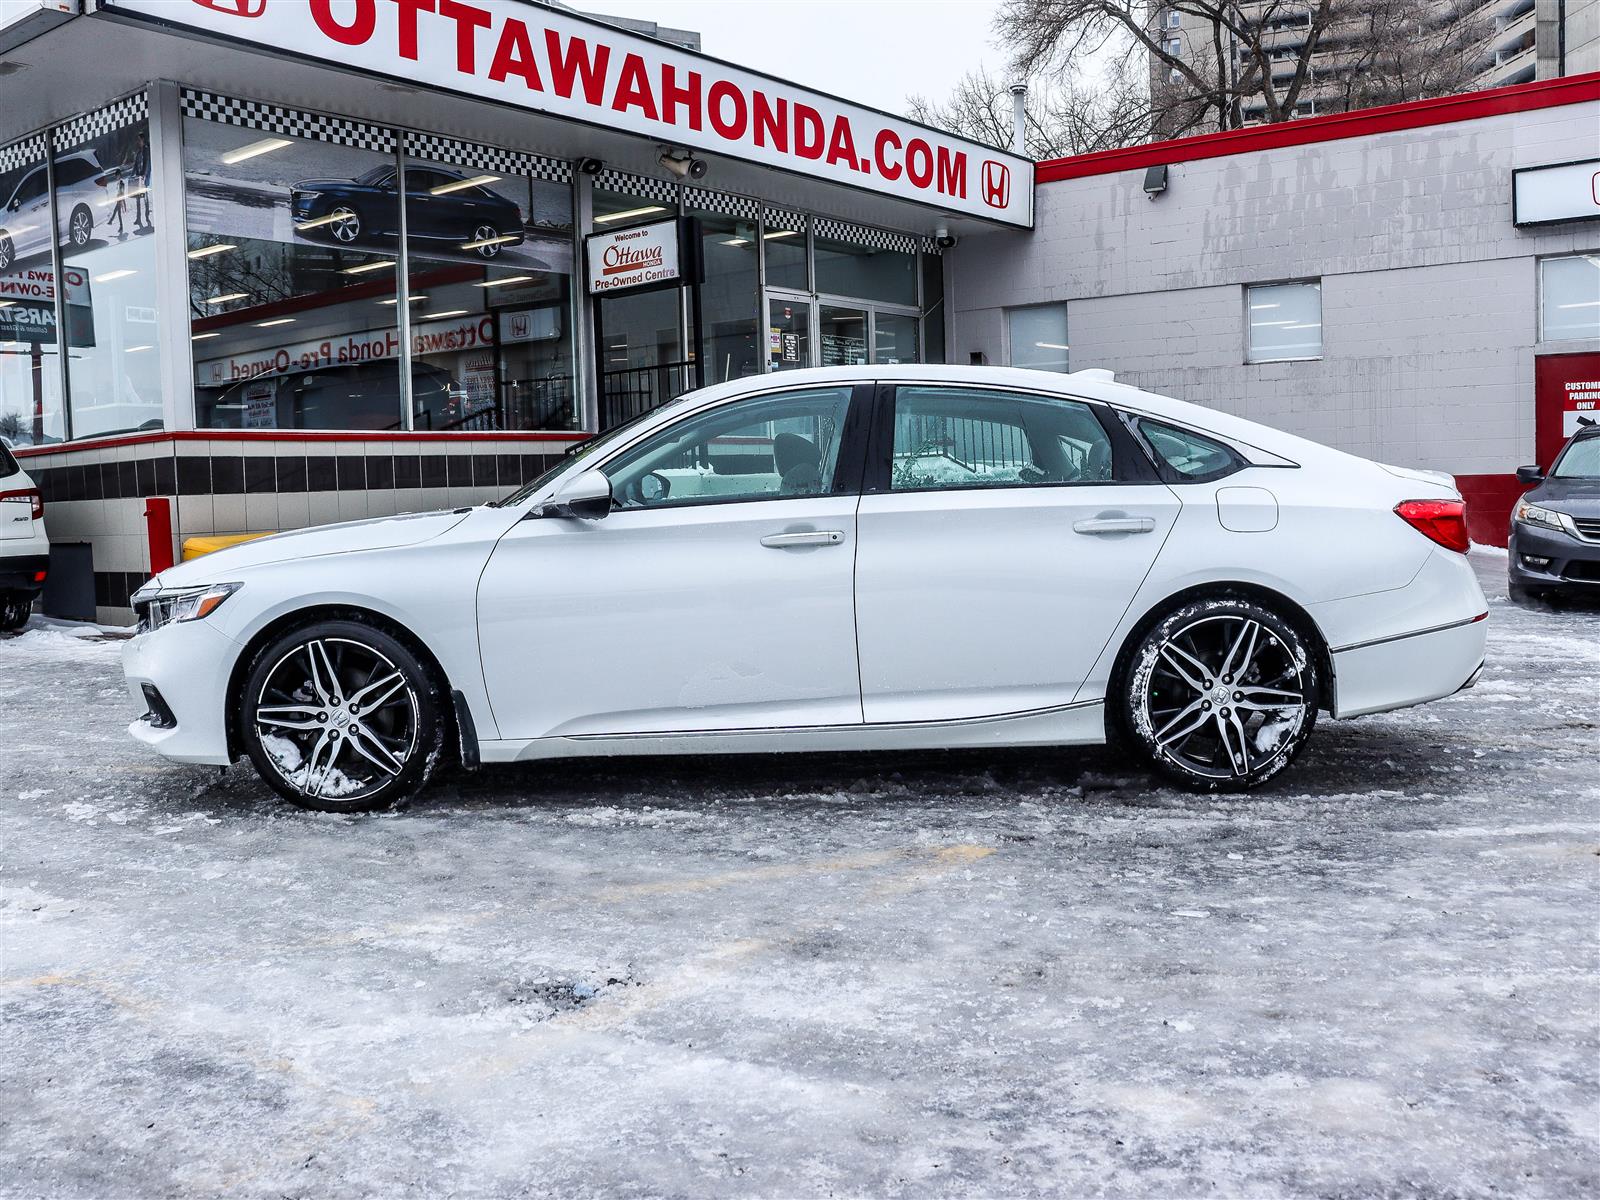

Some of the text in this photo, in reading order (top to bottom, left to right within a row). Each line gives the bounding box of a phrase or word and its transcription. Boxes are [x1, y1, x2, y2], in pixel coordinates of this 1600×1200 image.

[309, 0, 967, 200] OTTAWAHONDA.COM
[614, 230, 641, 242] Welcome
[603, 245, 662, 267] Ottawa
[642, 259, 661, 267] HONDA
[595, 268, 675, 290] Pre-Owned Centre
[1576, 401, 1596, 410] ONLY
